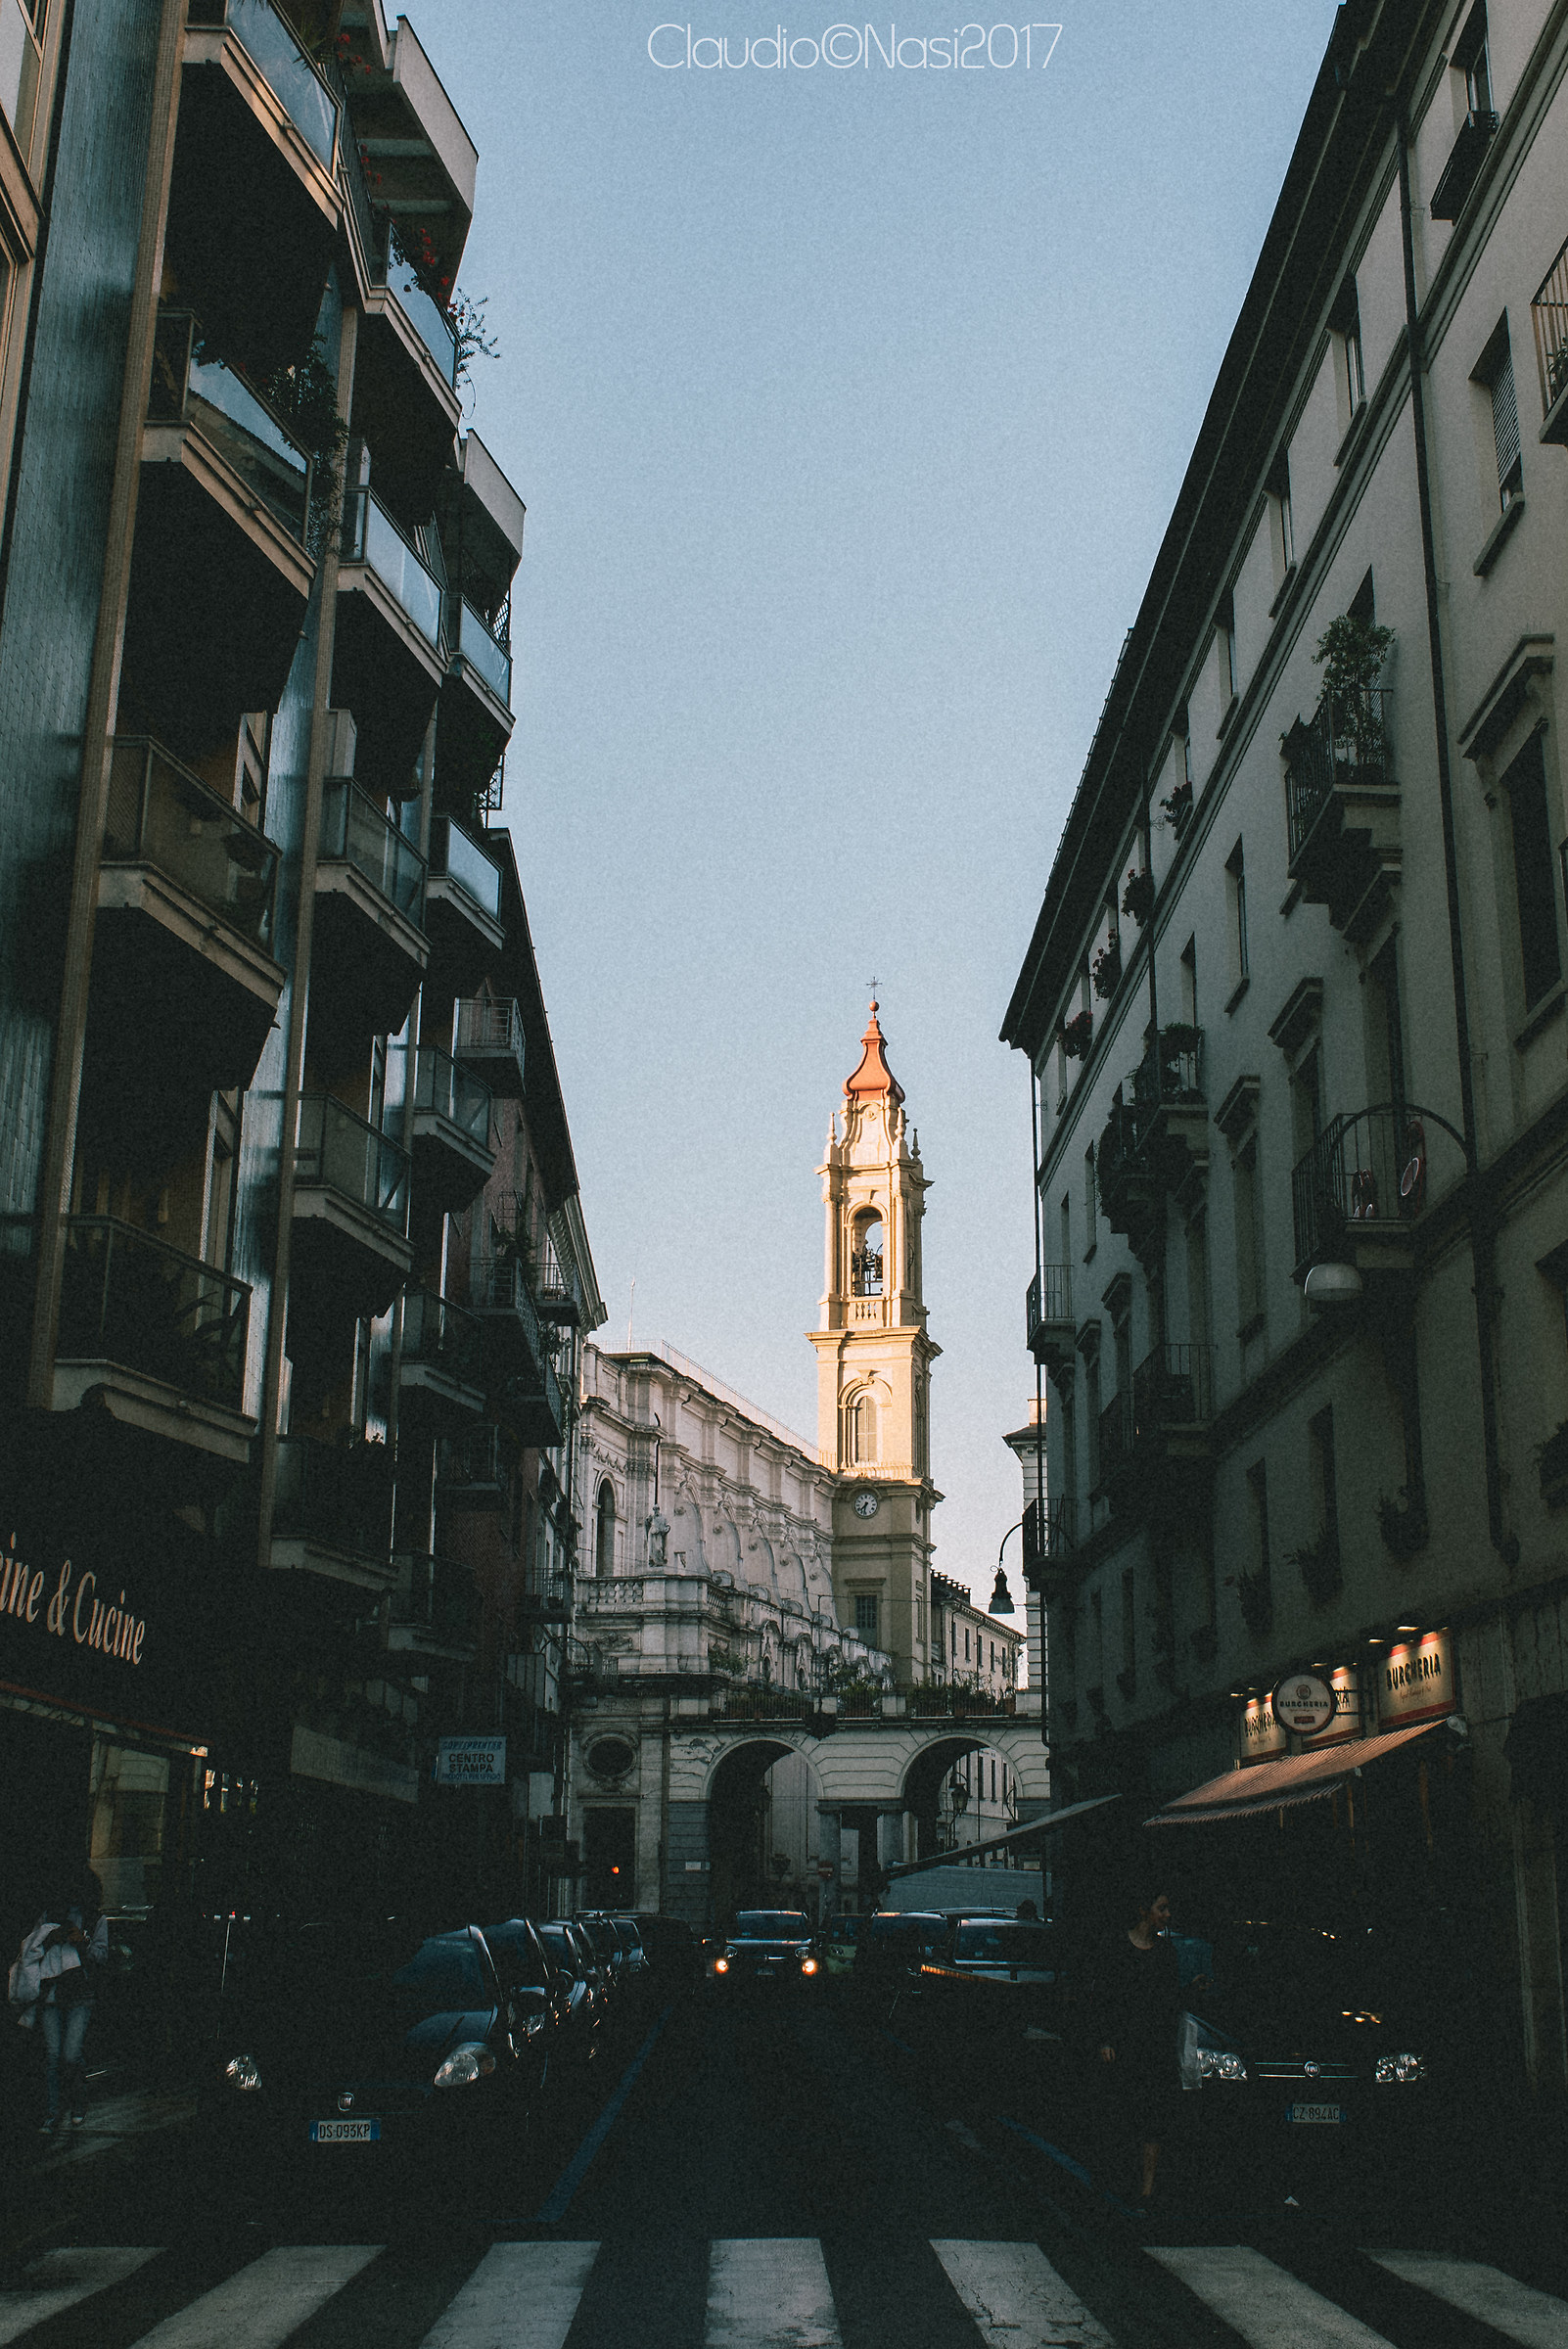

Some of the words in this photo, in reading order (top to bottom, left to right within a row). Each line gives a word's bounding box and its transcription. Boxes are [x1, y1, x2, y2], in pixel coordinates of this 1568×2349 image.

[0, 1531, 45, 1624] ine
[47, 1559, 71, 1636] &
[72, 1571, 146, 1665] Cucine
[448, 1753, 494, 1763] CENTRO
[449, 1763, 493, 1773] STAMPA
